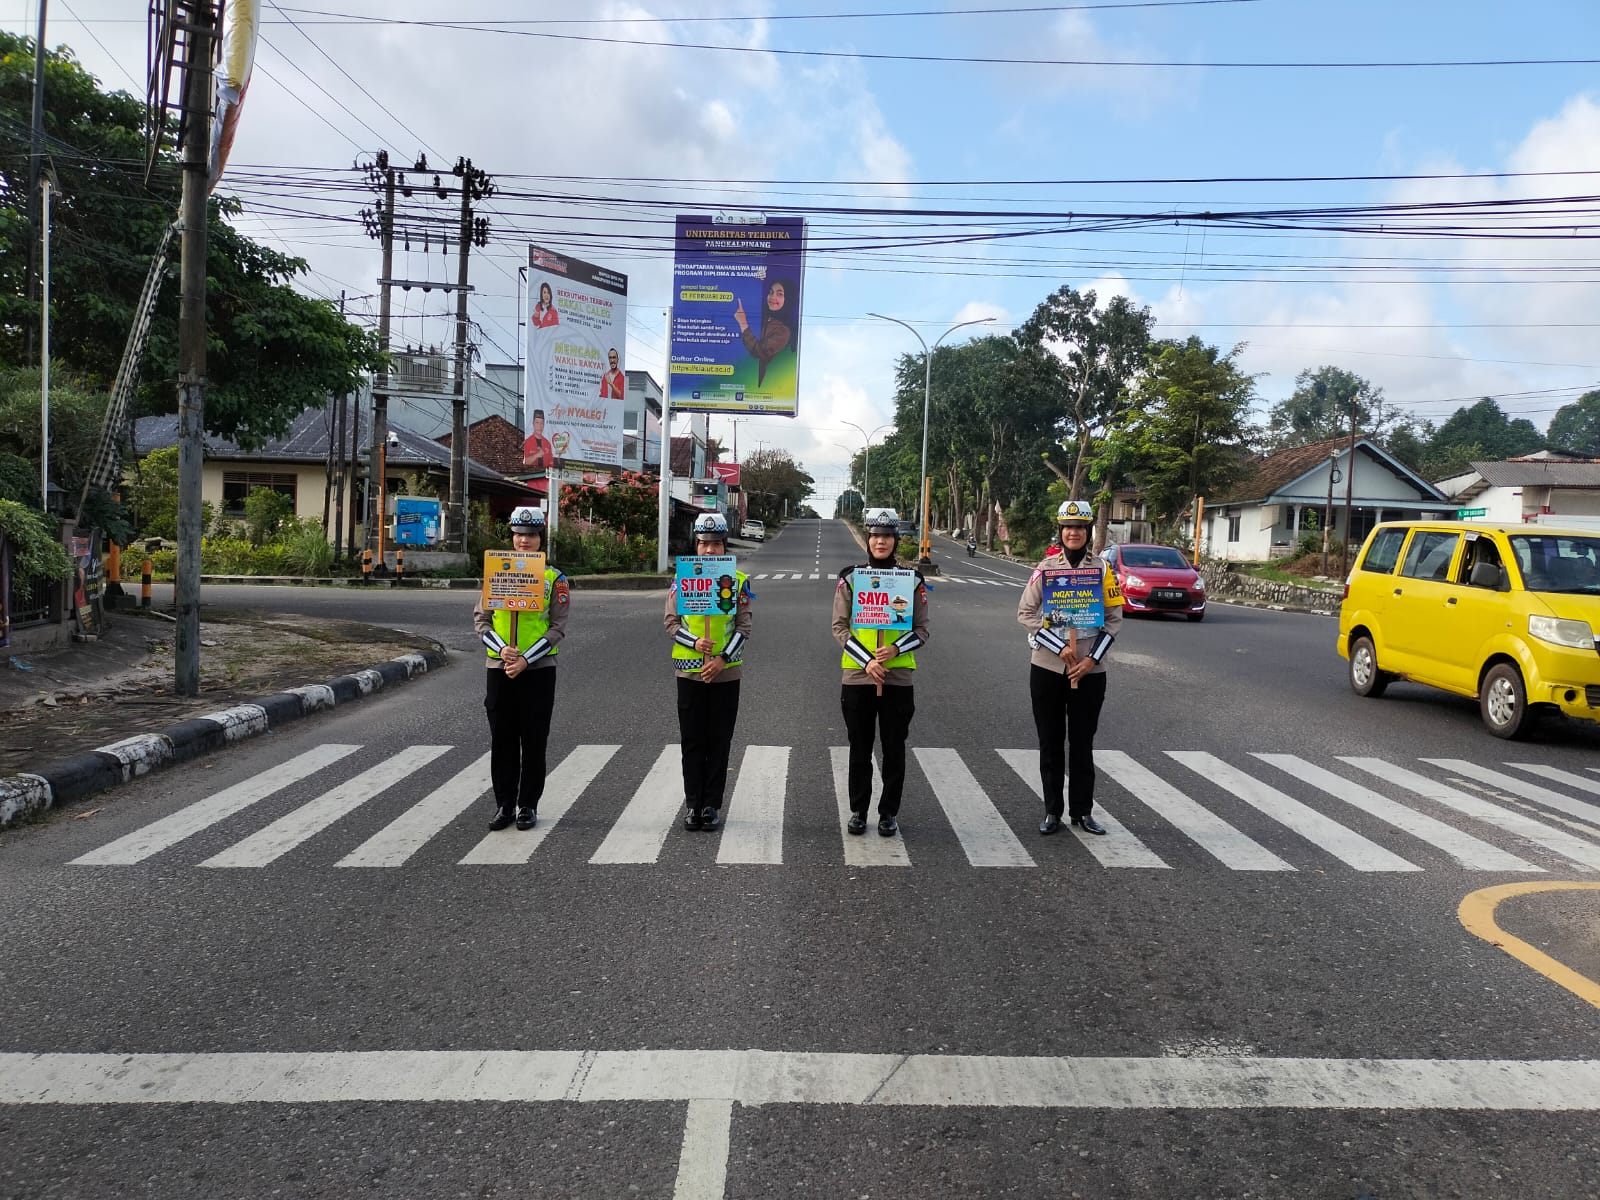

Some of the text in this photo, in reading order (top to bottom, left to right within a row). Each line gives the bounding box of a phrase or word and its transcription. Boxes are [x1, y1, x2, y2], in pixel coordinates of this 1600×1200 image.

[685, 230, 790, 239] UNIVERSITAS TERBUKA
[705, 240, 771, 248] PANGKALPINANG
[557, 290, 613, 308] REKRUTMEN TERBUKA
[558, 298, 610, 318] BAKAL CALEG
[554, 356, 606, 370] WAKIL RAKYAT
[681, 578, 712, 592] STOP
[858, 592, 889, 605] SAYA
